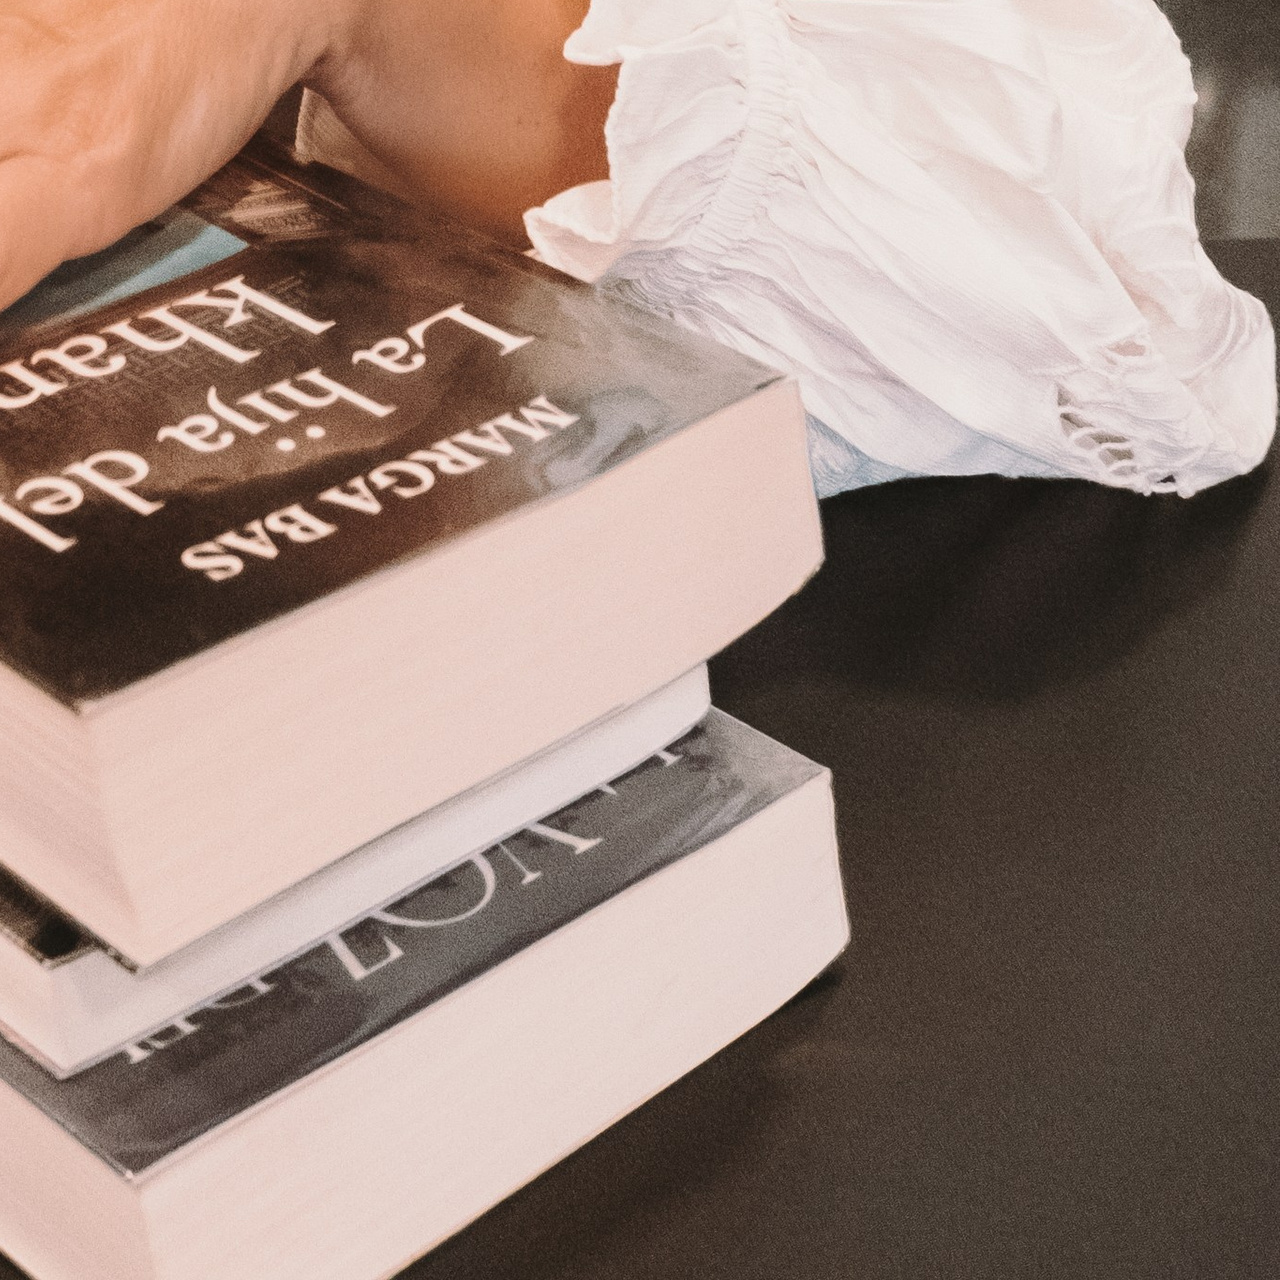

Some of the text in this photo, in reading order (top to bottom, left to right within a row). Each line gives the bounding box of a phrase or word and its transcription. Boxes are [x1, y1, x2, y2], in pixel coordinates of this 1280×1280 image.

[351, 303, 535, 374] La
[156, 368, 398, 453] hija
[181, 395, 581, 582] MARGA BAS
